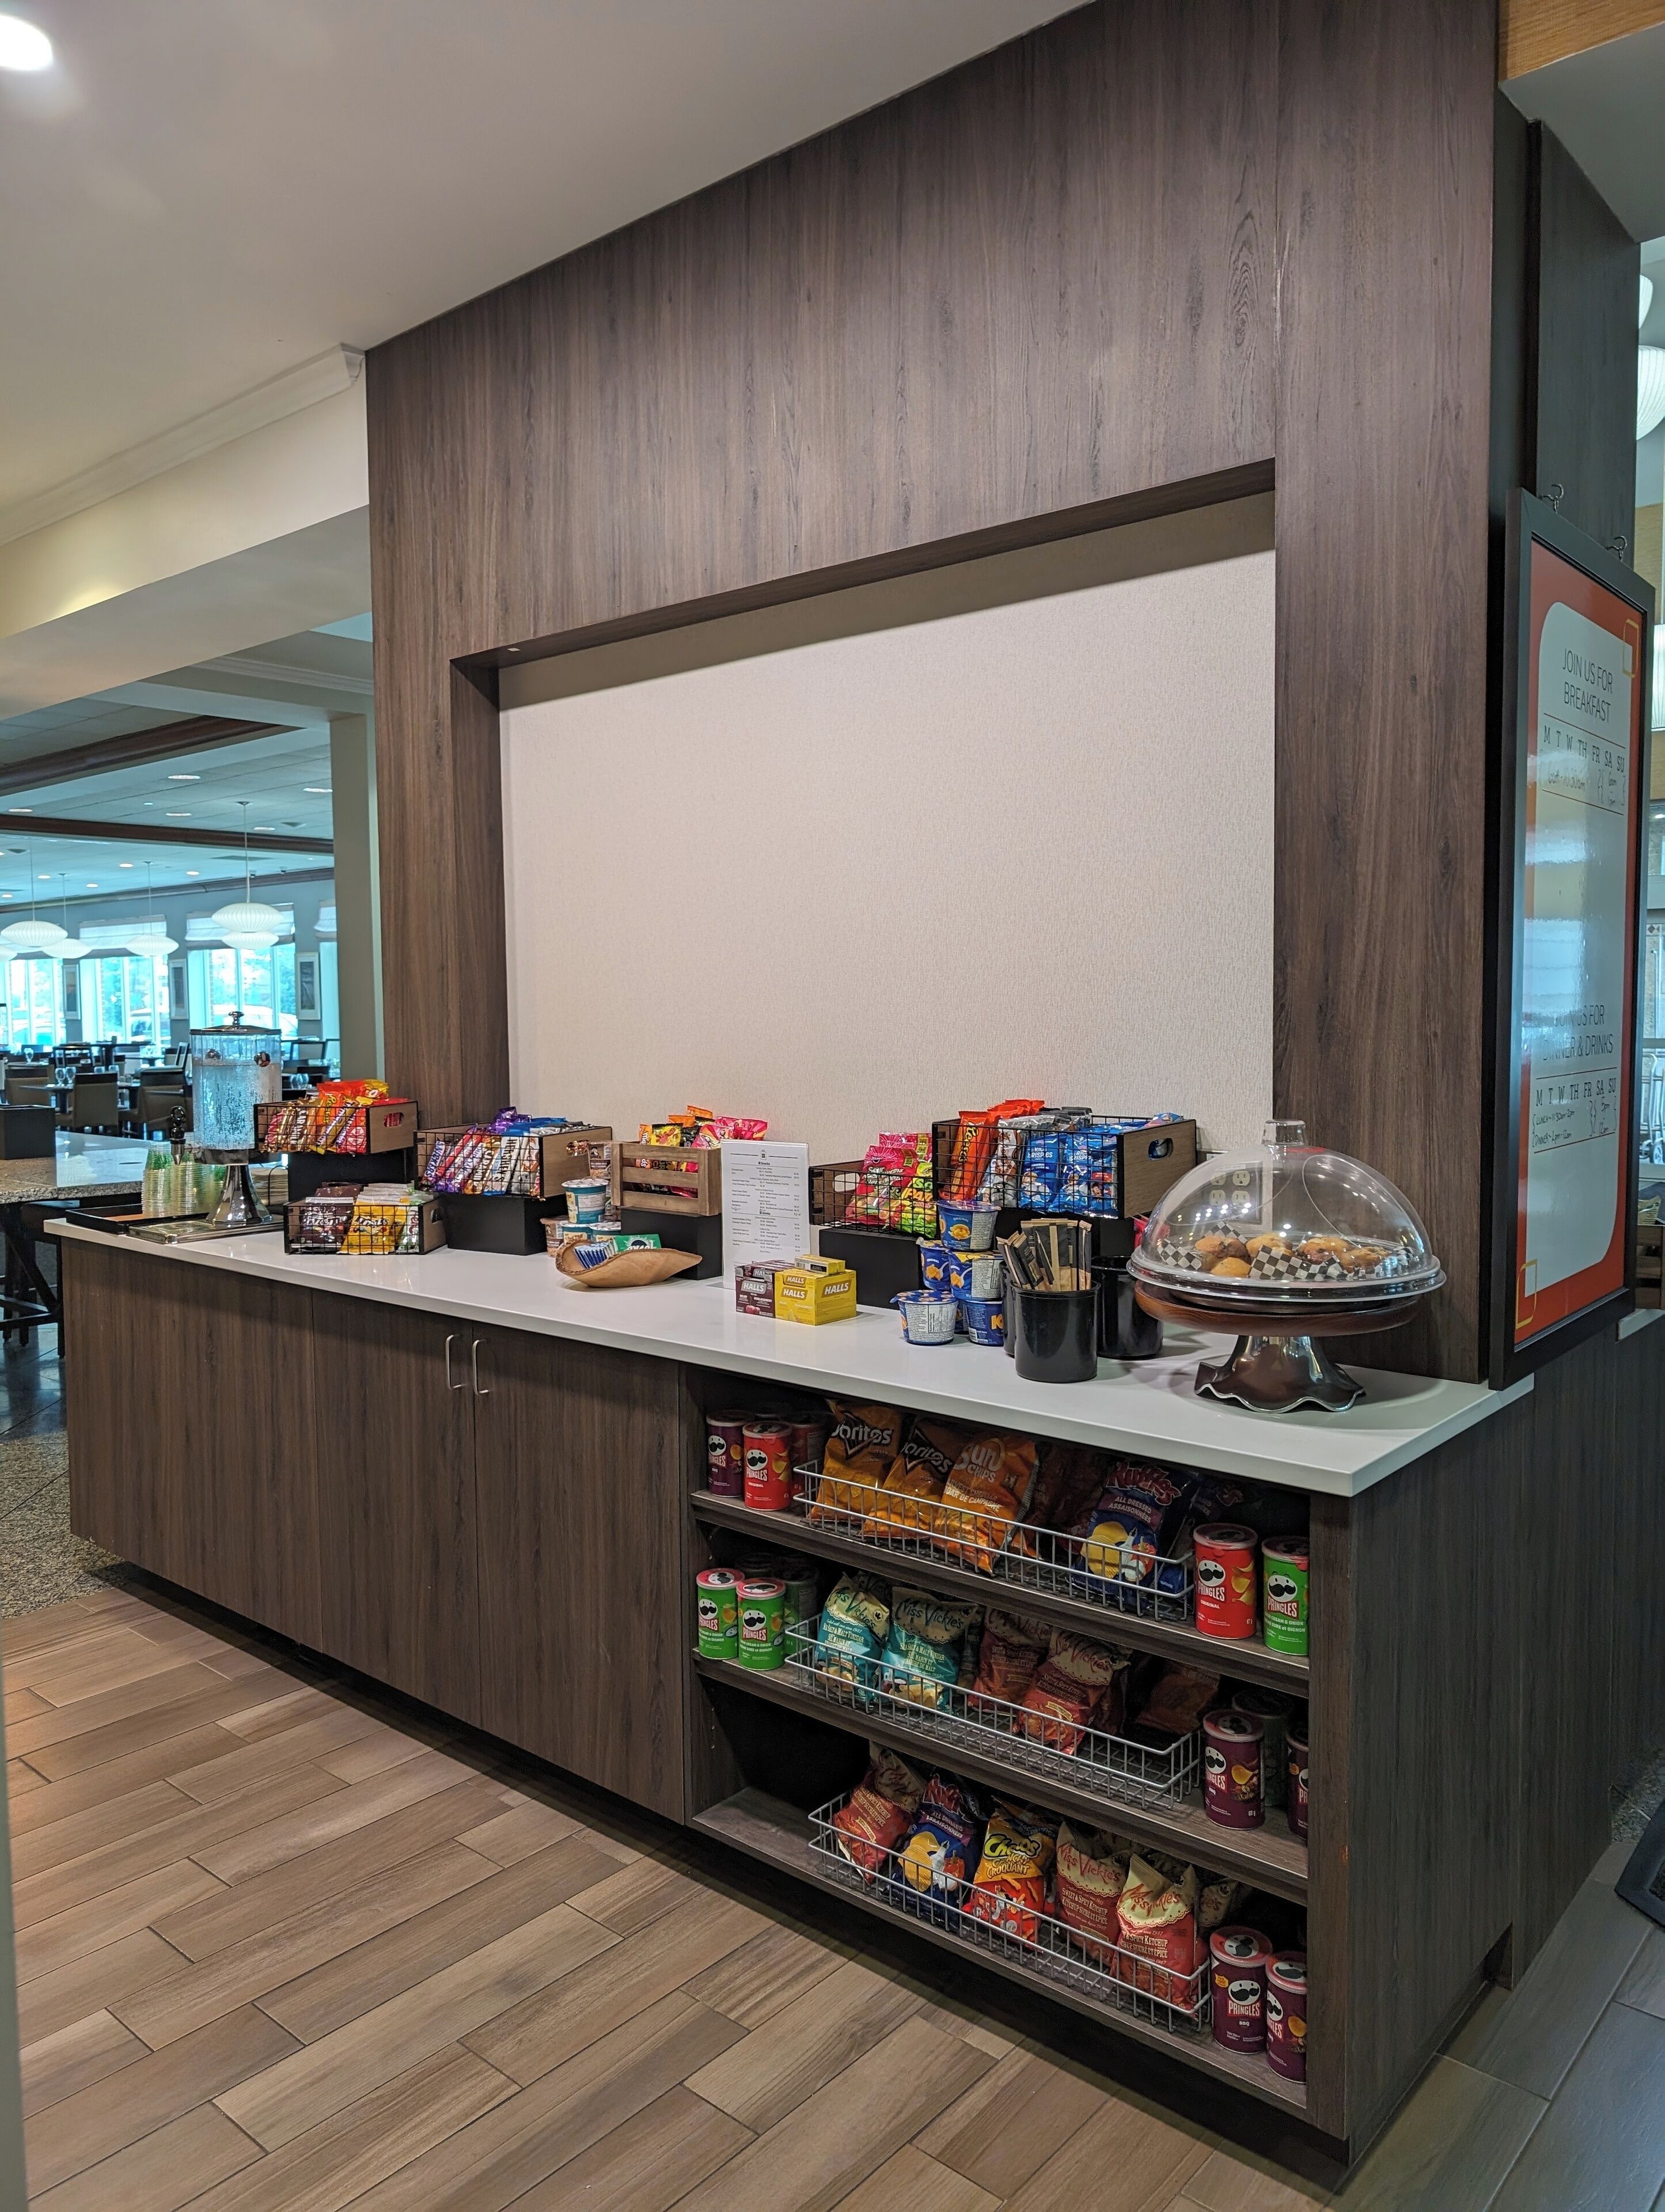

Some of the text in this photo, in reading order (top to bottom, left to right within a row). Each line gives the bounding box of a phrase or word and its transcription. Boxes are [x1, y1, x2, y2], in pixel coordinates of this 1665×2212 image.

[1562, 648, 1613, 694] JOIN US FOR
[1564, 681, 1611, 723] BREAKFAST
[1544, 726, 1625, 772] M T W TH FR SA SU
[1554, 1005, 1605, 1028] JOIN US FOR
[1543, 1033, 1613, 1060] DINNER & DRINKS
[1536, 1078, 1616, 1106] M T W TH FR SA SU
[494, 1138, 517, 1181] HERSHEY'S
[906, 1189, 932, 1202] PAT
[744, 1282, 764, 1291] HALLS
[787, 1276, 804, 1284] HALLS
[783, 1289, 805, 1298] HALLS
[824, 1282, 849, 1295] HALLS
[746, 1467, 767, 1481] PRINGLES
[968, 1465, 996, 1483] CHIPS
[960, 1494, 1001, 1512] DE CAMPAGNE
[1128, 1499, 1151, 1513] DRESSED
[1199, 1581, 1225, 1601] PRINGLES
[1200, 1600, 1220, 1609] ORIGINAL
[1268, 1596, 1298, 1618] PRINGLES
[743, 1627, 767, 1641] PRINGLES
[837, 1628, 848, 1637] MALT
[916, 1653, 927, 1663] MARIN
[919, 1646, 930, 1656] MALT
[930, 1649, 945, 1661] VINEGAR
[868, 1793, 878, 1805] SPICY
[876, 1802, 891, 1819] KETCHUP
[931, 1812, 962, 1831] ALL DRESSED
[987, 1862, 1031, 1878] CROQUANT
[1057, 1842, 1121, 1884] Miss Vickie's
[1062, 1896, 1079, 1911] KETCHUP
[1063, 1888, 1075, 1900] SWEET
[1079, 1895, 1089, 1906] SPICY
[1090, 1901, 1108, 1916] KETCHUP
[1130, 1934, 1144, 1943] SPICY
[1144, 1935, 1168, 1947] KETCHUP
[1228, 2000, 1260, 2016] PRINGLES
